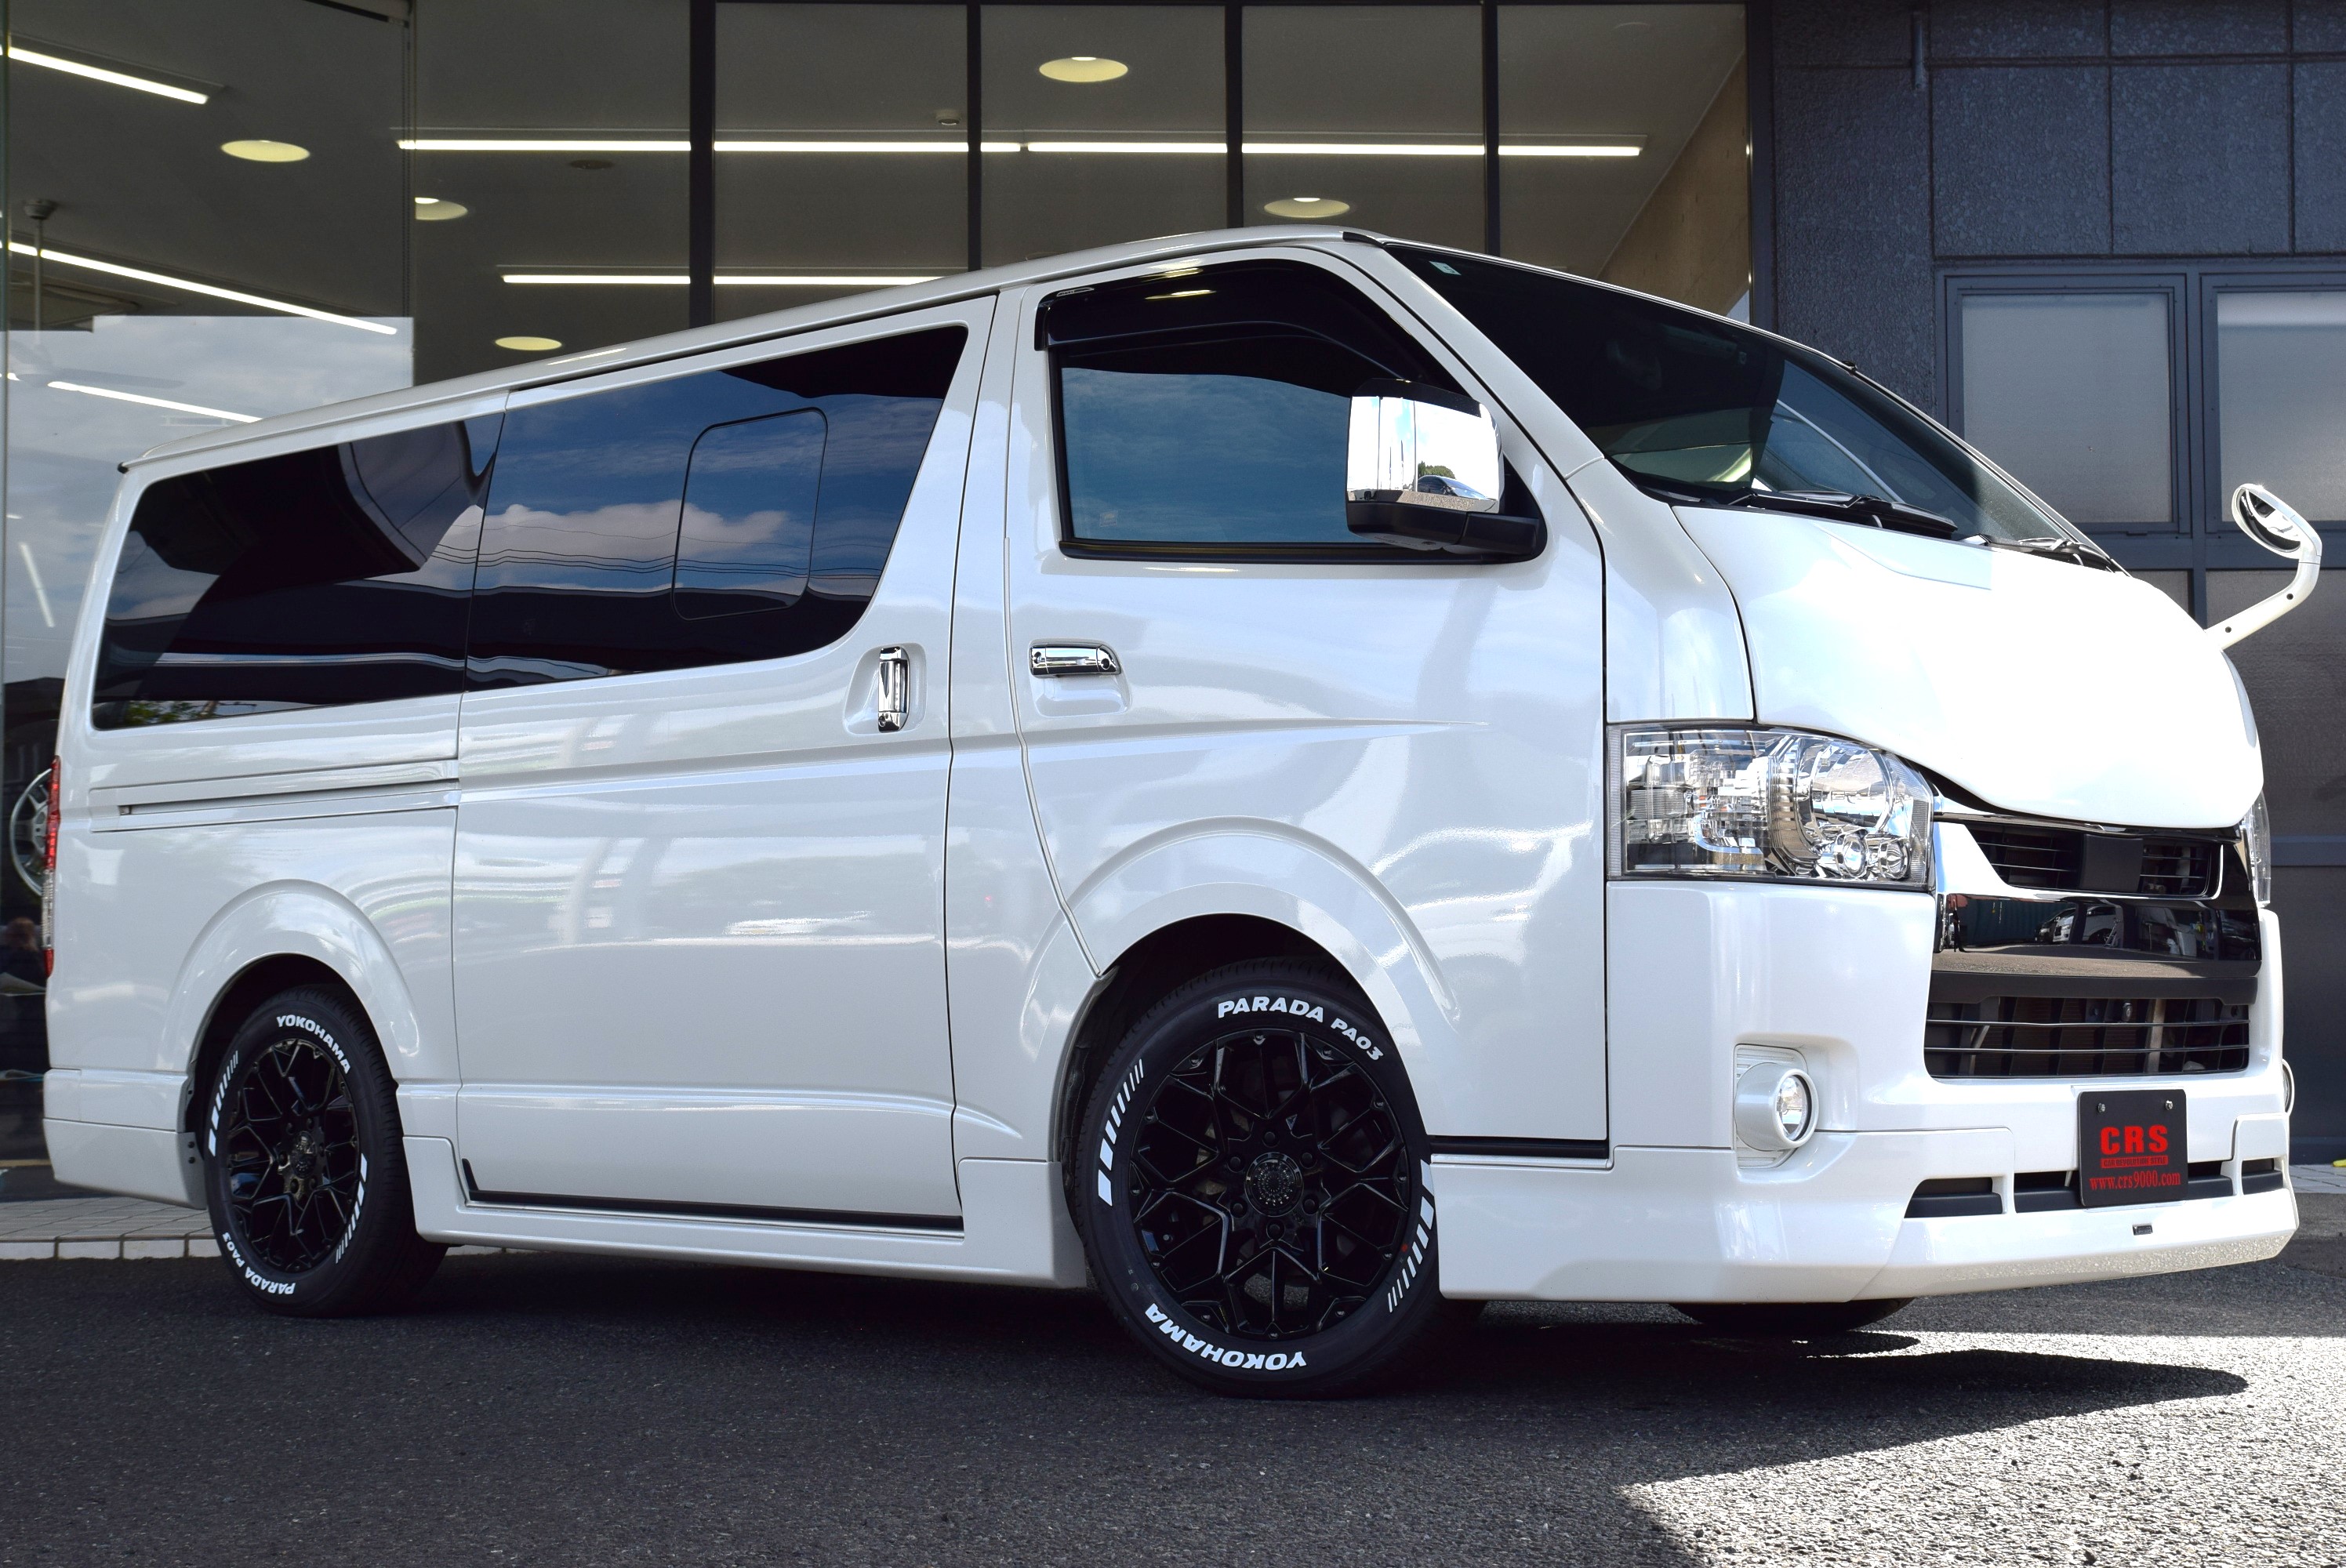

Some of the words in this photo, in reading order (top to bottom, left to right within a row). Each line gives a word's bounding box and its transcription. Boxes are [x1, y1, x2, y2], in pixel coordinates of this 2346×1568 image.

[1218, 996, 1324, 1022] PARADA
[276, 1014, 350, 1074] YOKOHAMA
[2101, 1124, 2168, 1155] CRS
[2090, 1170, 2181, 1191] www.crs9000.com
[245, 1266, 296, 1294] PARADA
[1145, 1303, 1307, 1370] YOKOHAMA
